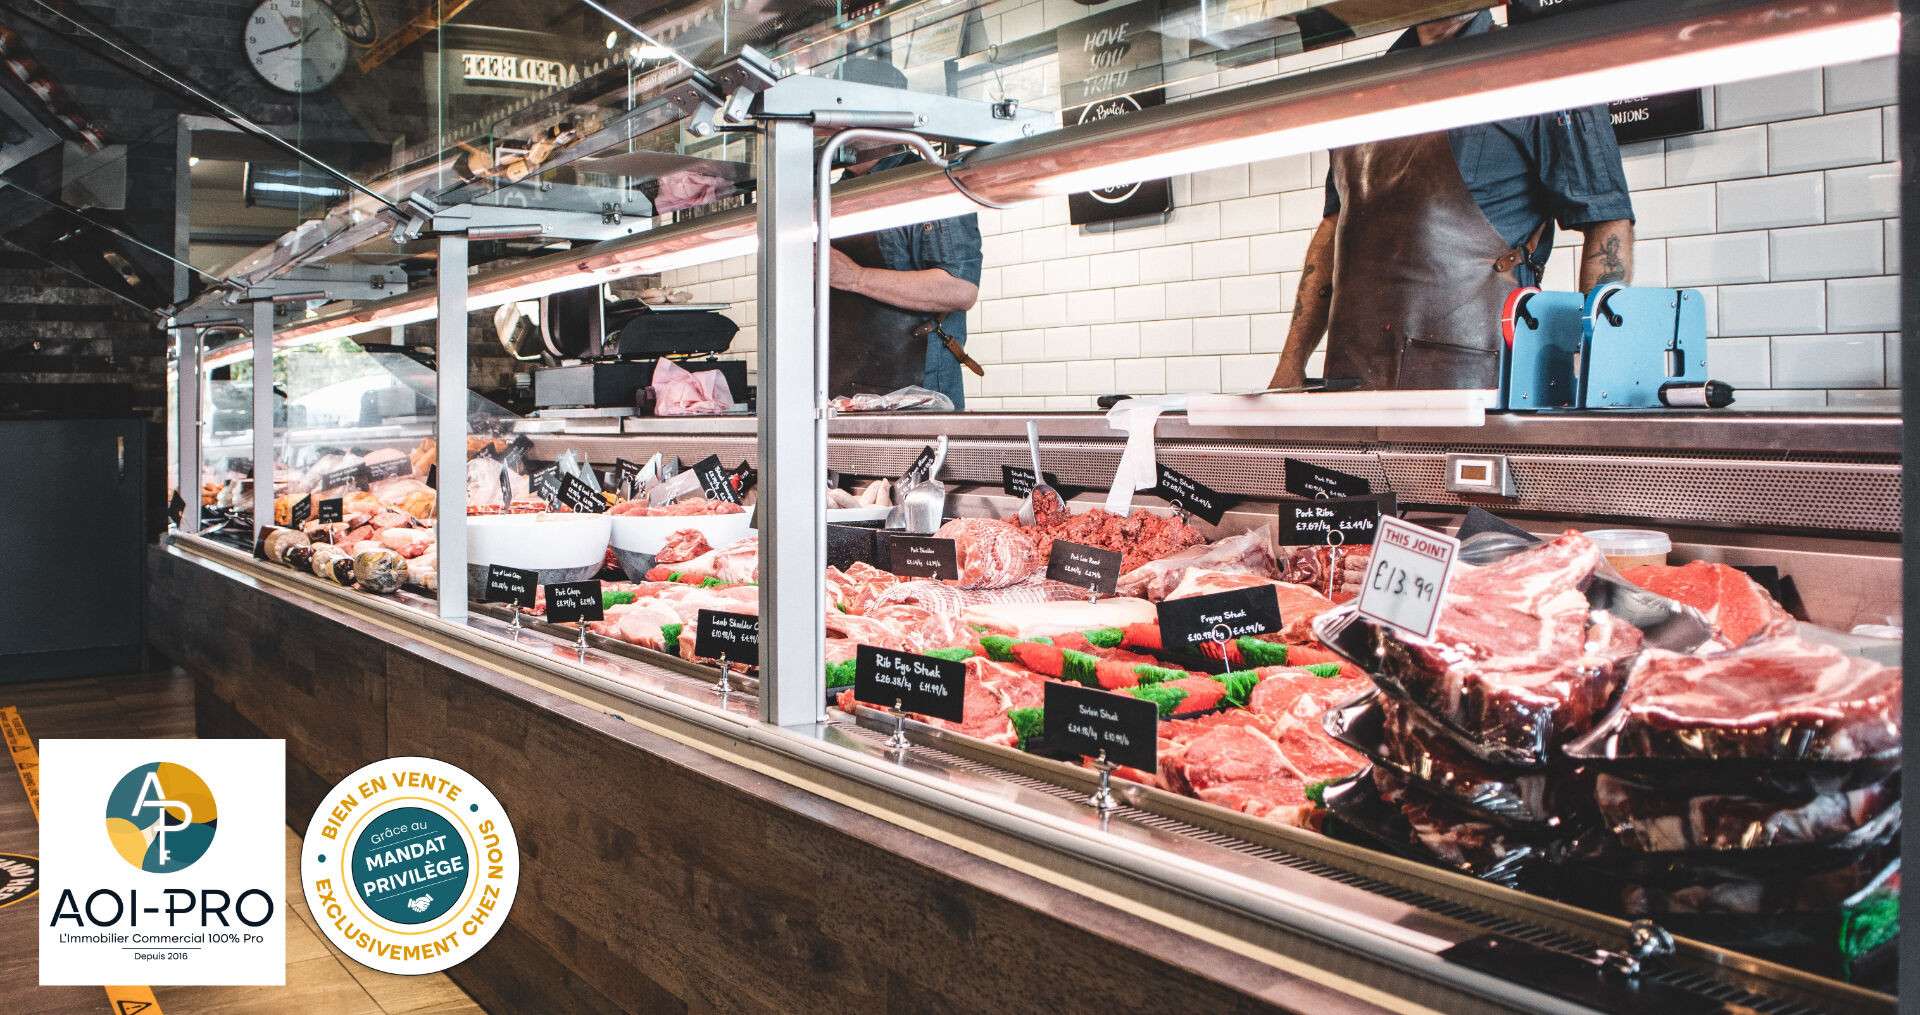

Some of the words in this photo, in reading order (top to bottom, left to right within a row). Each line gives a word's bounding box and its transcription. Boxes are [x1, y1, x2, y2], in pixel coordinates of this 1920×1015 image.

[249, 36, 257, 45] 9
[1295, 507, 1314, 519] Pork
[1315, 506, 1335, 518] Ribs
[1386, 528, 1411, 547] THIS
[1412, 539, 1448, 559] JOINT
[1373, 559, 1434, 603] £13.99
[712, 615, 728, 627] Lamb
[1200, 613, 1223, 625] Frying
[1223, 608, 1248, 620] Steak
[875, 652, 892, 669] Rib
[894, 657, 912, 676] Eye
[912, 660, 942, 679] Steak
[874, 671, 913, 692] £26.38/kg
[919, 681, 949, 697] £11.99/lb
[1099, 708, 1120, 722] Steak
